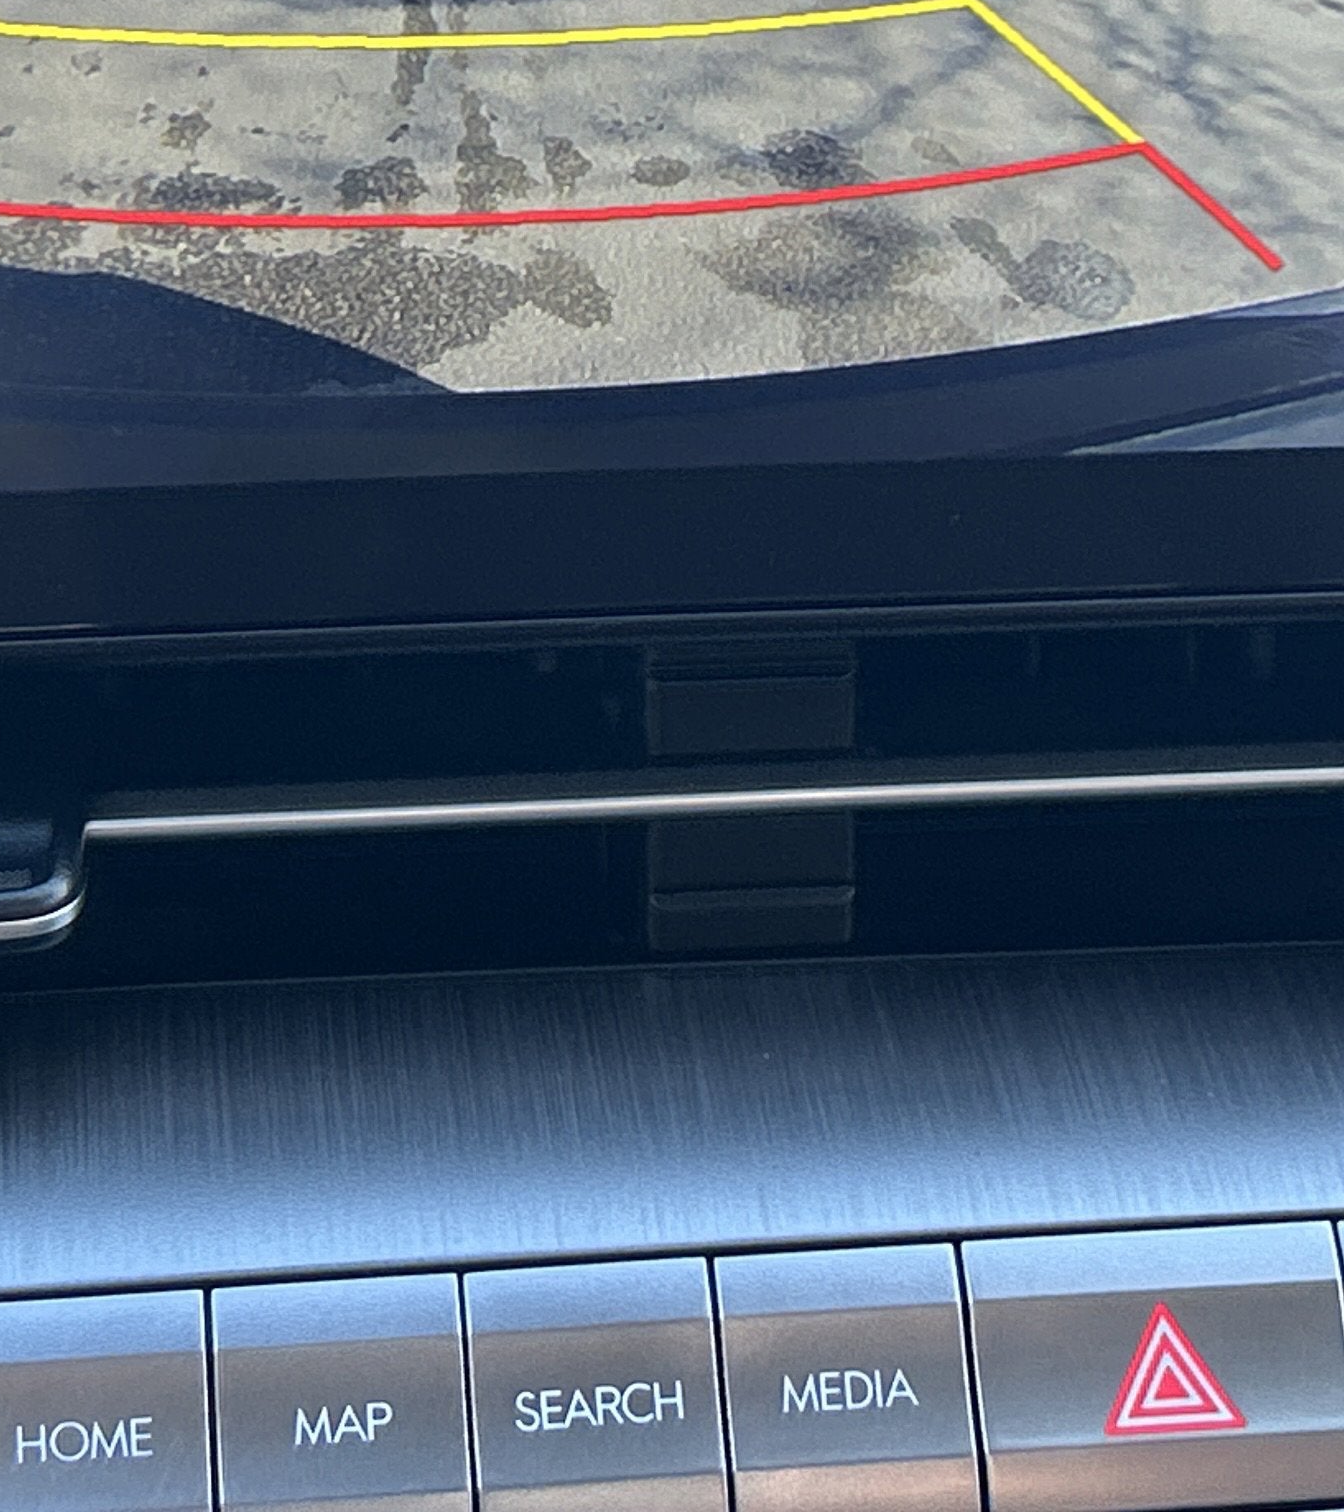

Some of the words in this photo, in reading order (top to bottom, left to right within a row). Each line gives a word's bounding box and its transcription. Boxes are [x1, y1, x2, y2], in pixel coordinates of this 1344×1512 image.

[514, 1379, 685, 1432] SEARCH
[781, 1368, 919, 1414] MEDIA
[15, 1416, 154, 1464] HOME
[293, 1400, 394, 1446] MAP
